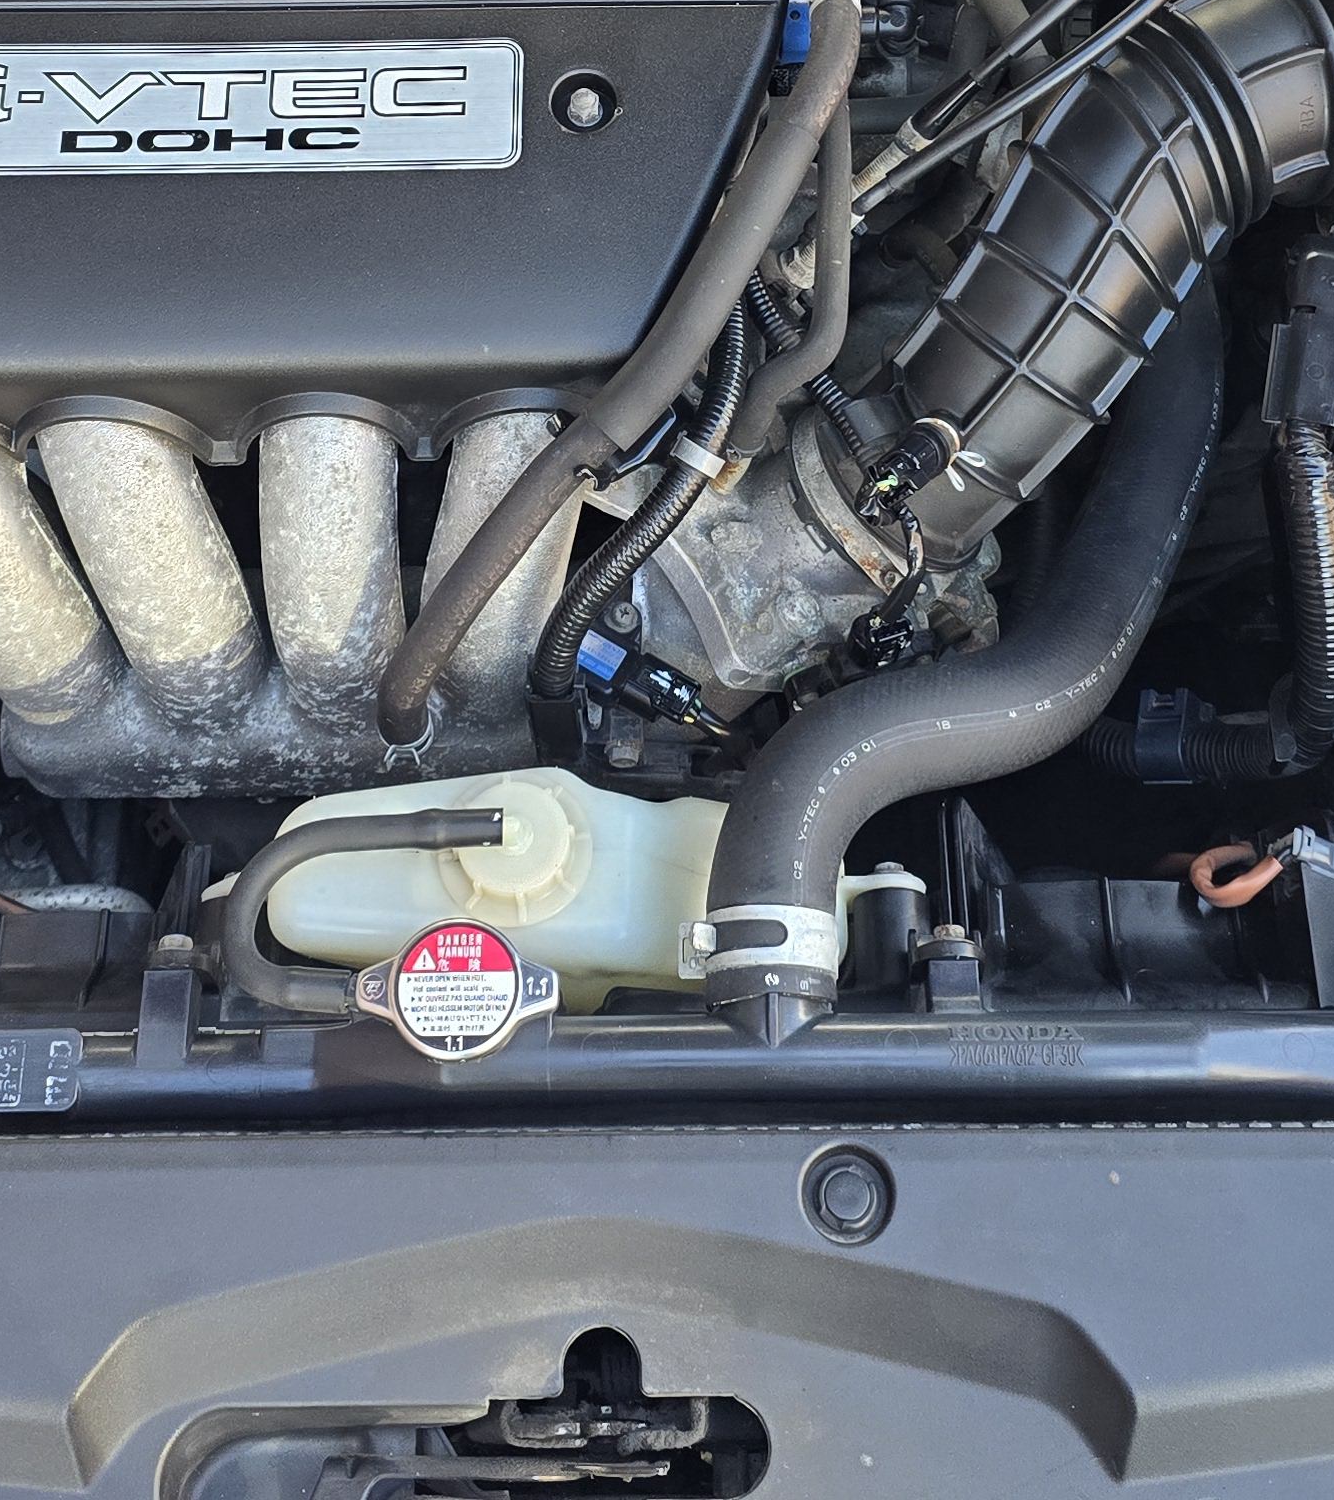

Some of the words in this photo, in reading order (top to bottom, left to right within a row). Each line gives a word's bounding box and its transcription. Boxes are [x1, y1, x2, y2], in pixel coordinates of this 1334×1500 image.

[1299, 95, 1315, 134] RBA
[60, 127, 362, 153] DOHC
[936, 720, 951, 731] 1B
[1035, 699, 1052, 711] C2
[1065, 673, 1099, 699] Y-TEC
[1116, 637, 1127, 652] 03
[1126, 623, 1135, 636] 01
[793, 860, 803, 880] C2
[798, 798, 820, 842] Y-TEC
[840, 752, 857, 768] 03
[861, 739, 877, 753] 01
[437, 933, 483, 946] DANGER
[437, 946, 481, 958] WARNUNG
[526, 976, 548, 996] 1.1
[463, 1004, 484, 1012] MOTOR
[948, 1026, 1085, 1041] HONDA
[444, 1035, 463, 1051] 1.1
